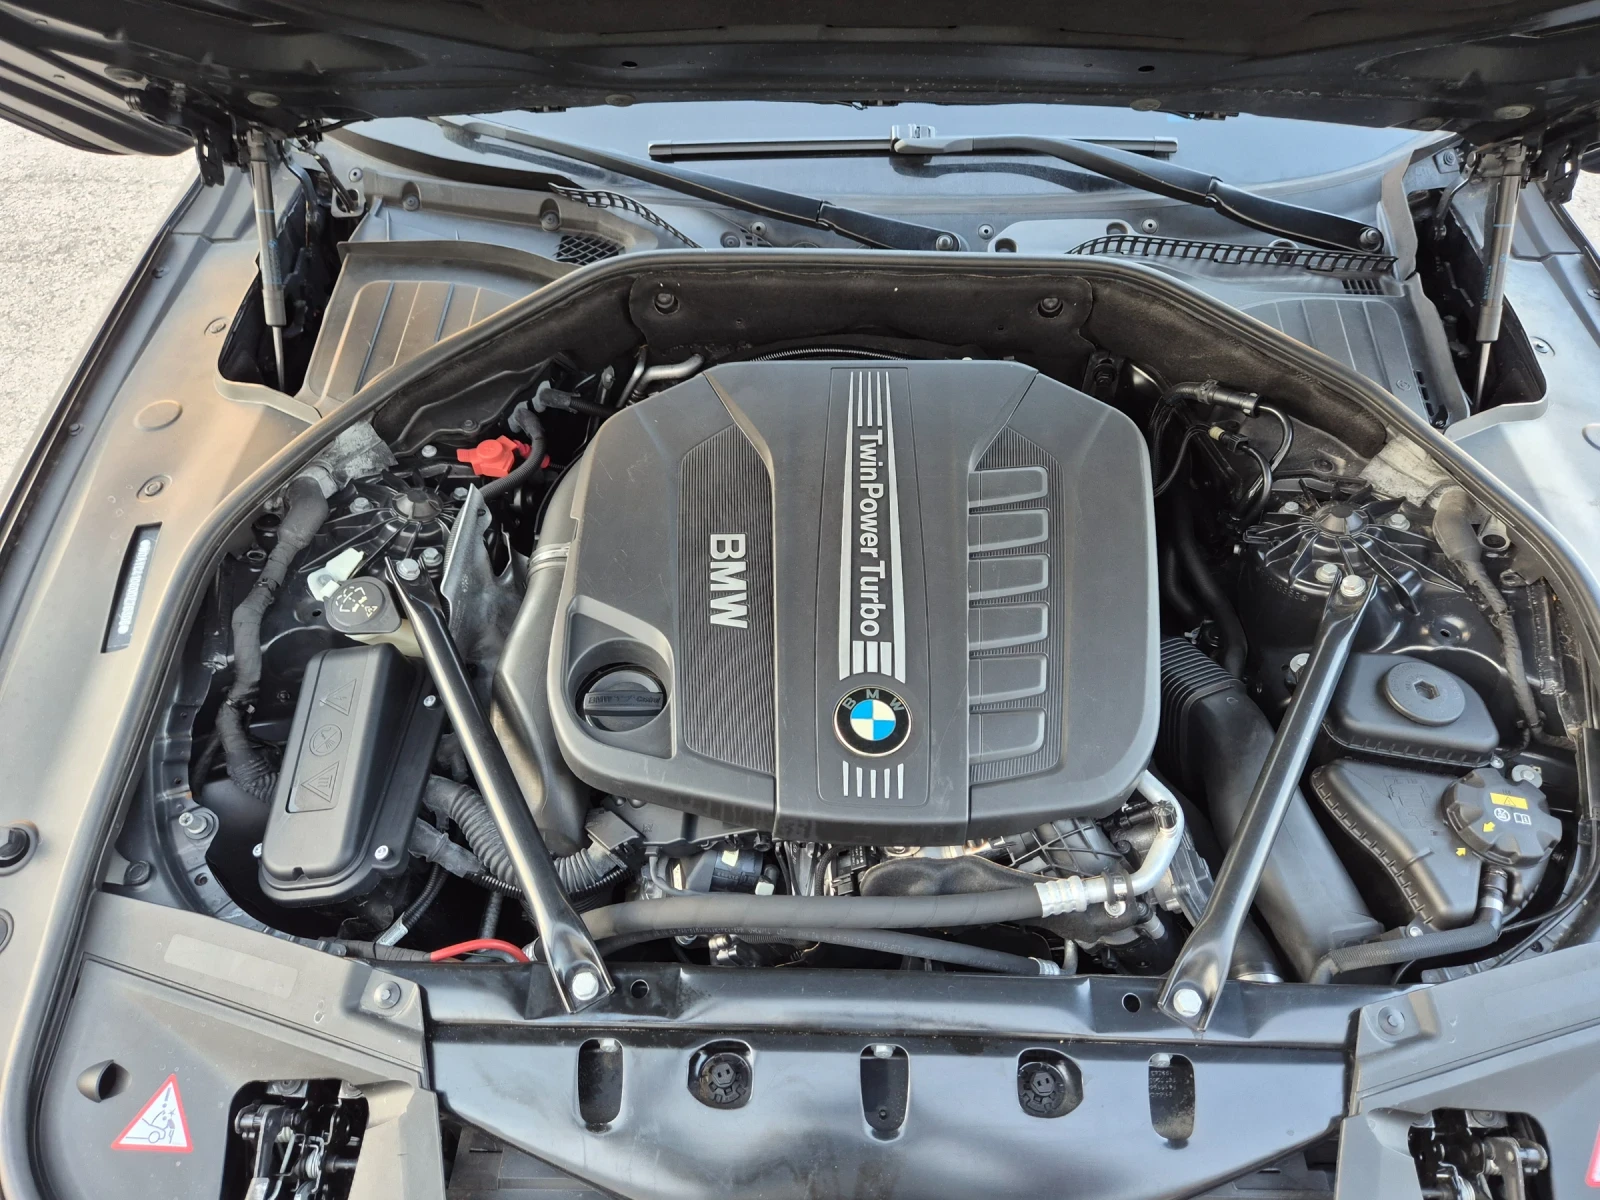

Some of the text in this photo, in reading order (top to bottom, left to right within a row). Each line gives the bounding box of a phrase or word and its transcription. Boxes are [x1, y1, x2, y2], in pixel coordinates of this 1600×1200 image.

[710, 533, 748, 629] BMW
[859, 429, 887, 637] TwinPower Turbo
[841, 688, 905, 712] BMW
